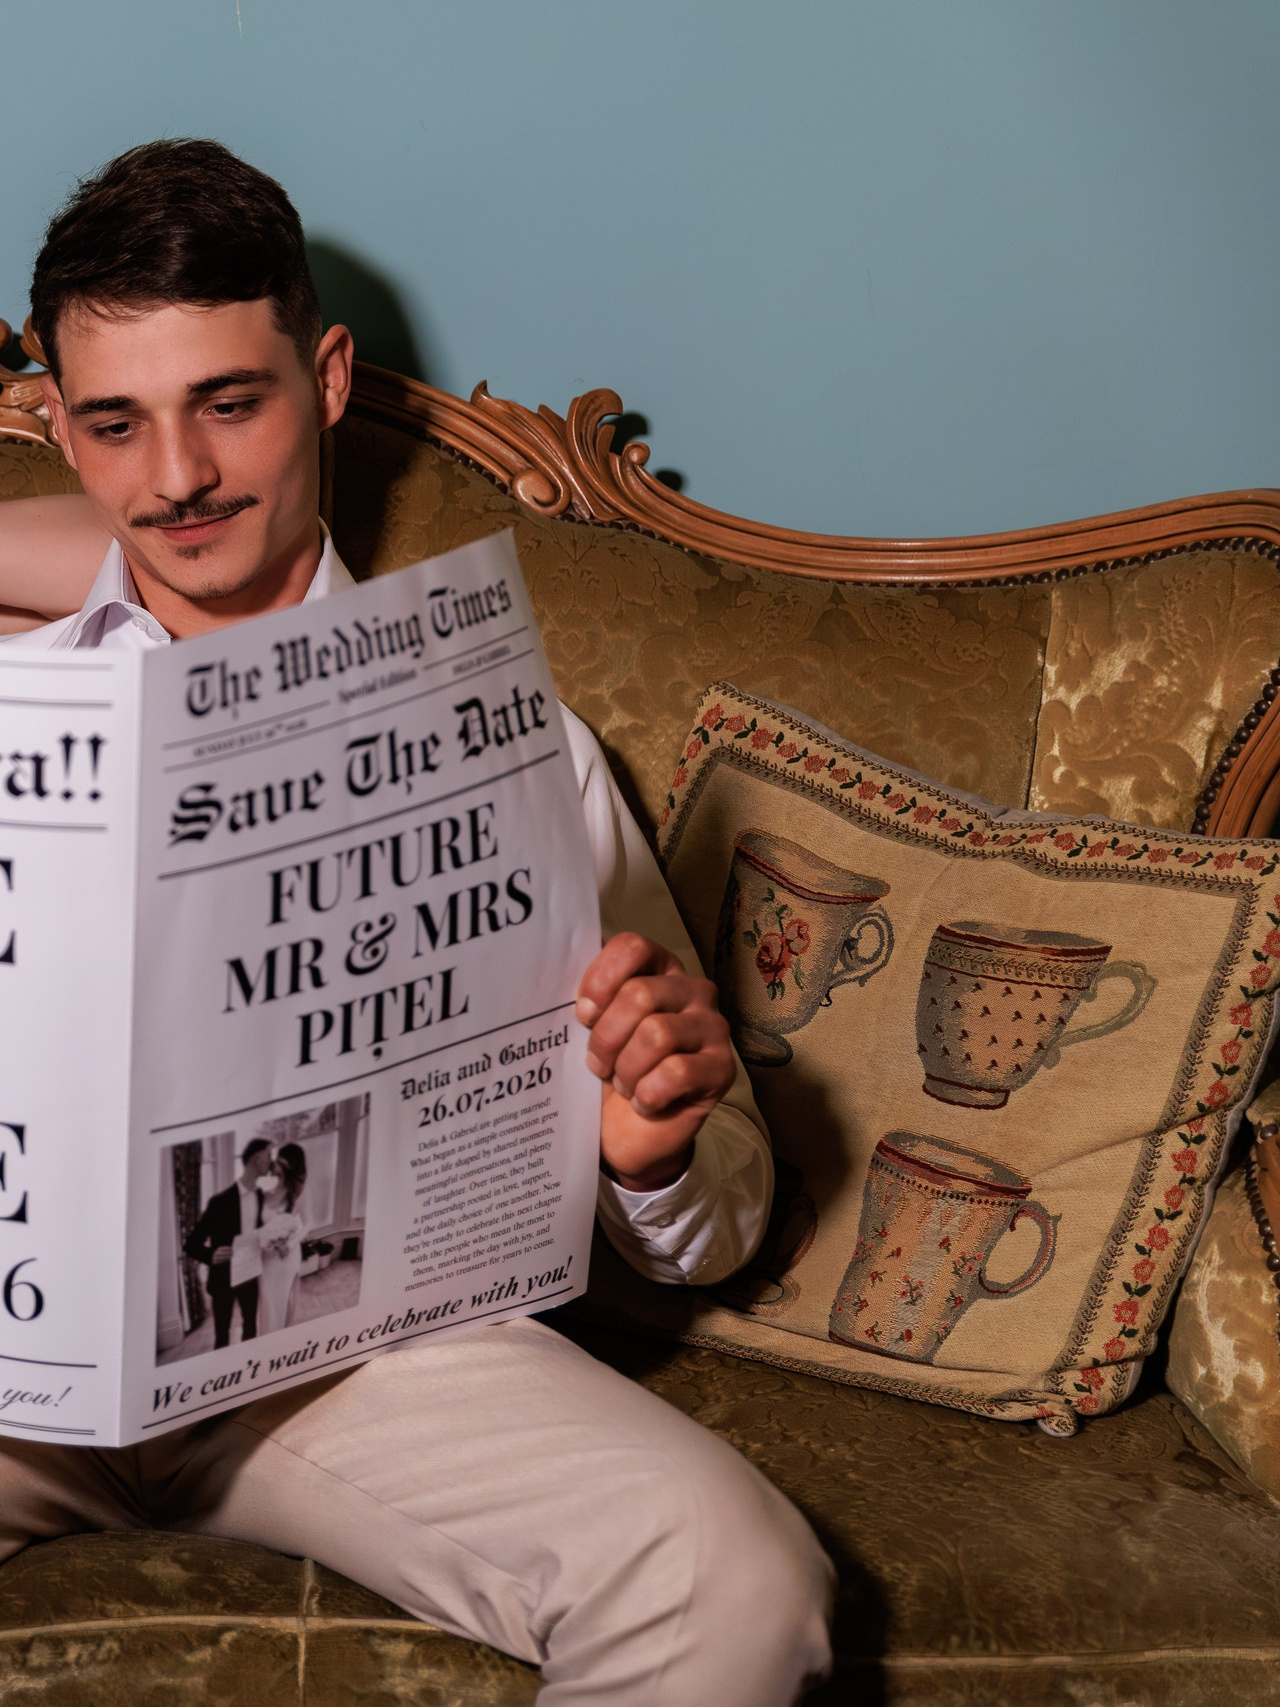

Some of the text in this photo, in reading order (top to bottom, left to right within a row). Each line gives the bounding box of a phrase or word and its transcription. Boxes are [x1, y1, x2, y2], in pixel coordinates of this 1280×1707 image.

[184, 656, 262, 720] The
[271, 615, 425, 693] Wedding
[427, 577, 512, 639] Times
[167, 768, 325, 848] Save
[344, 727, 441, 798] The
[454, 685, 549, 762] Date
[266, 802, 499, 927] FUTURE
[223, 866, 534, 1014] MR & MRS
[401, 1024, 569, 1101] Delia and Gabriel
[417, 1057, 553, 1128] 26.07.2026
[152, 1386, 192, 1414] We
[268, 1338, 320, 1375] wait
[325, 1332, 350, 1356] to
[355, 1296, 464, 1346] celebrate
[470, 1273, 519, 1309] with
[521, 1255, 574, 1299] you!
